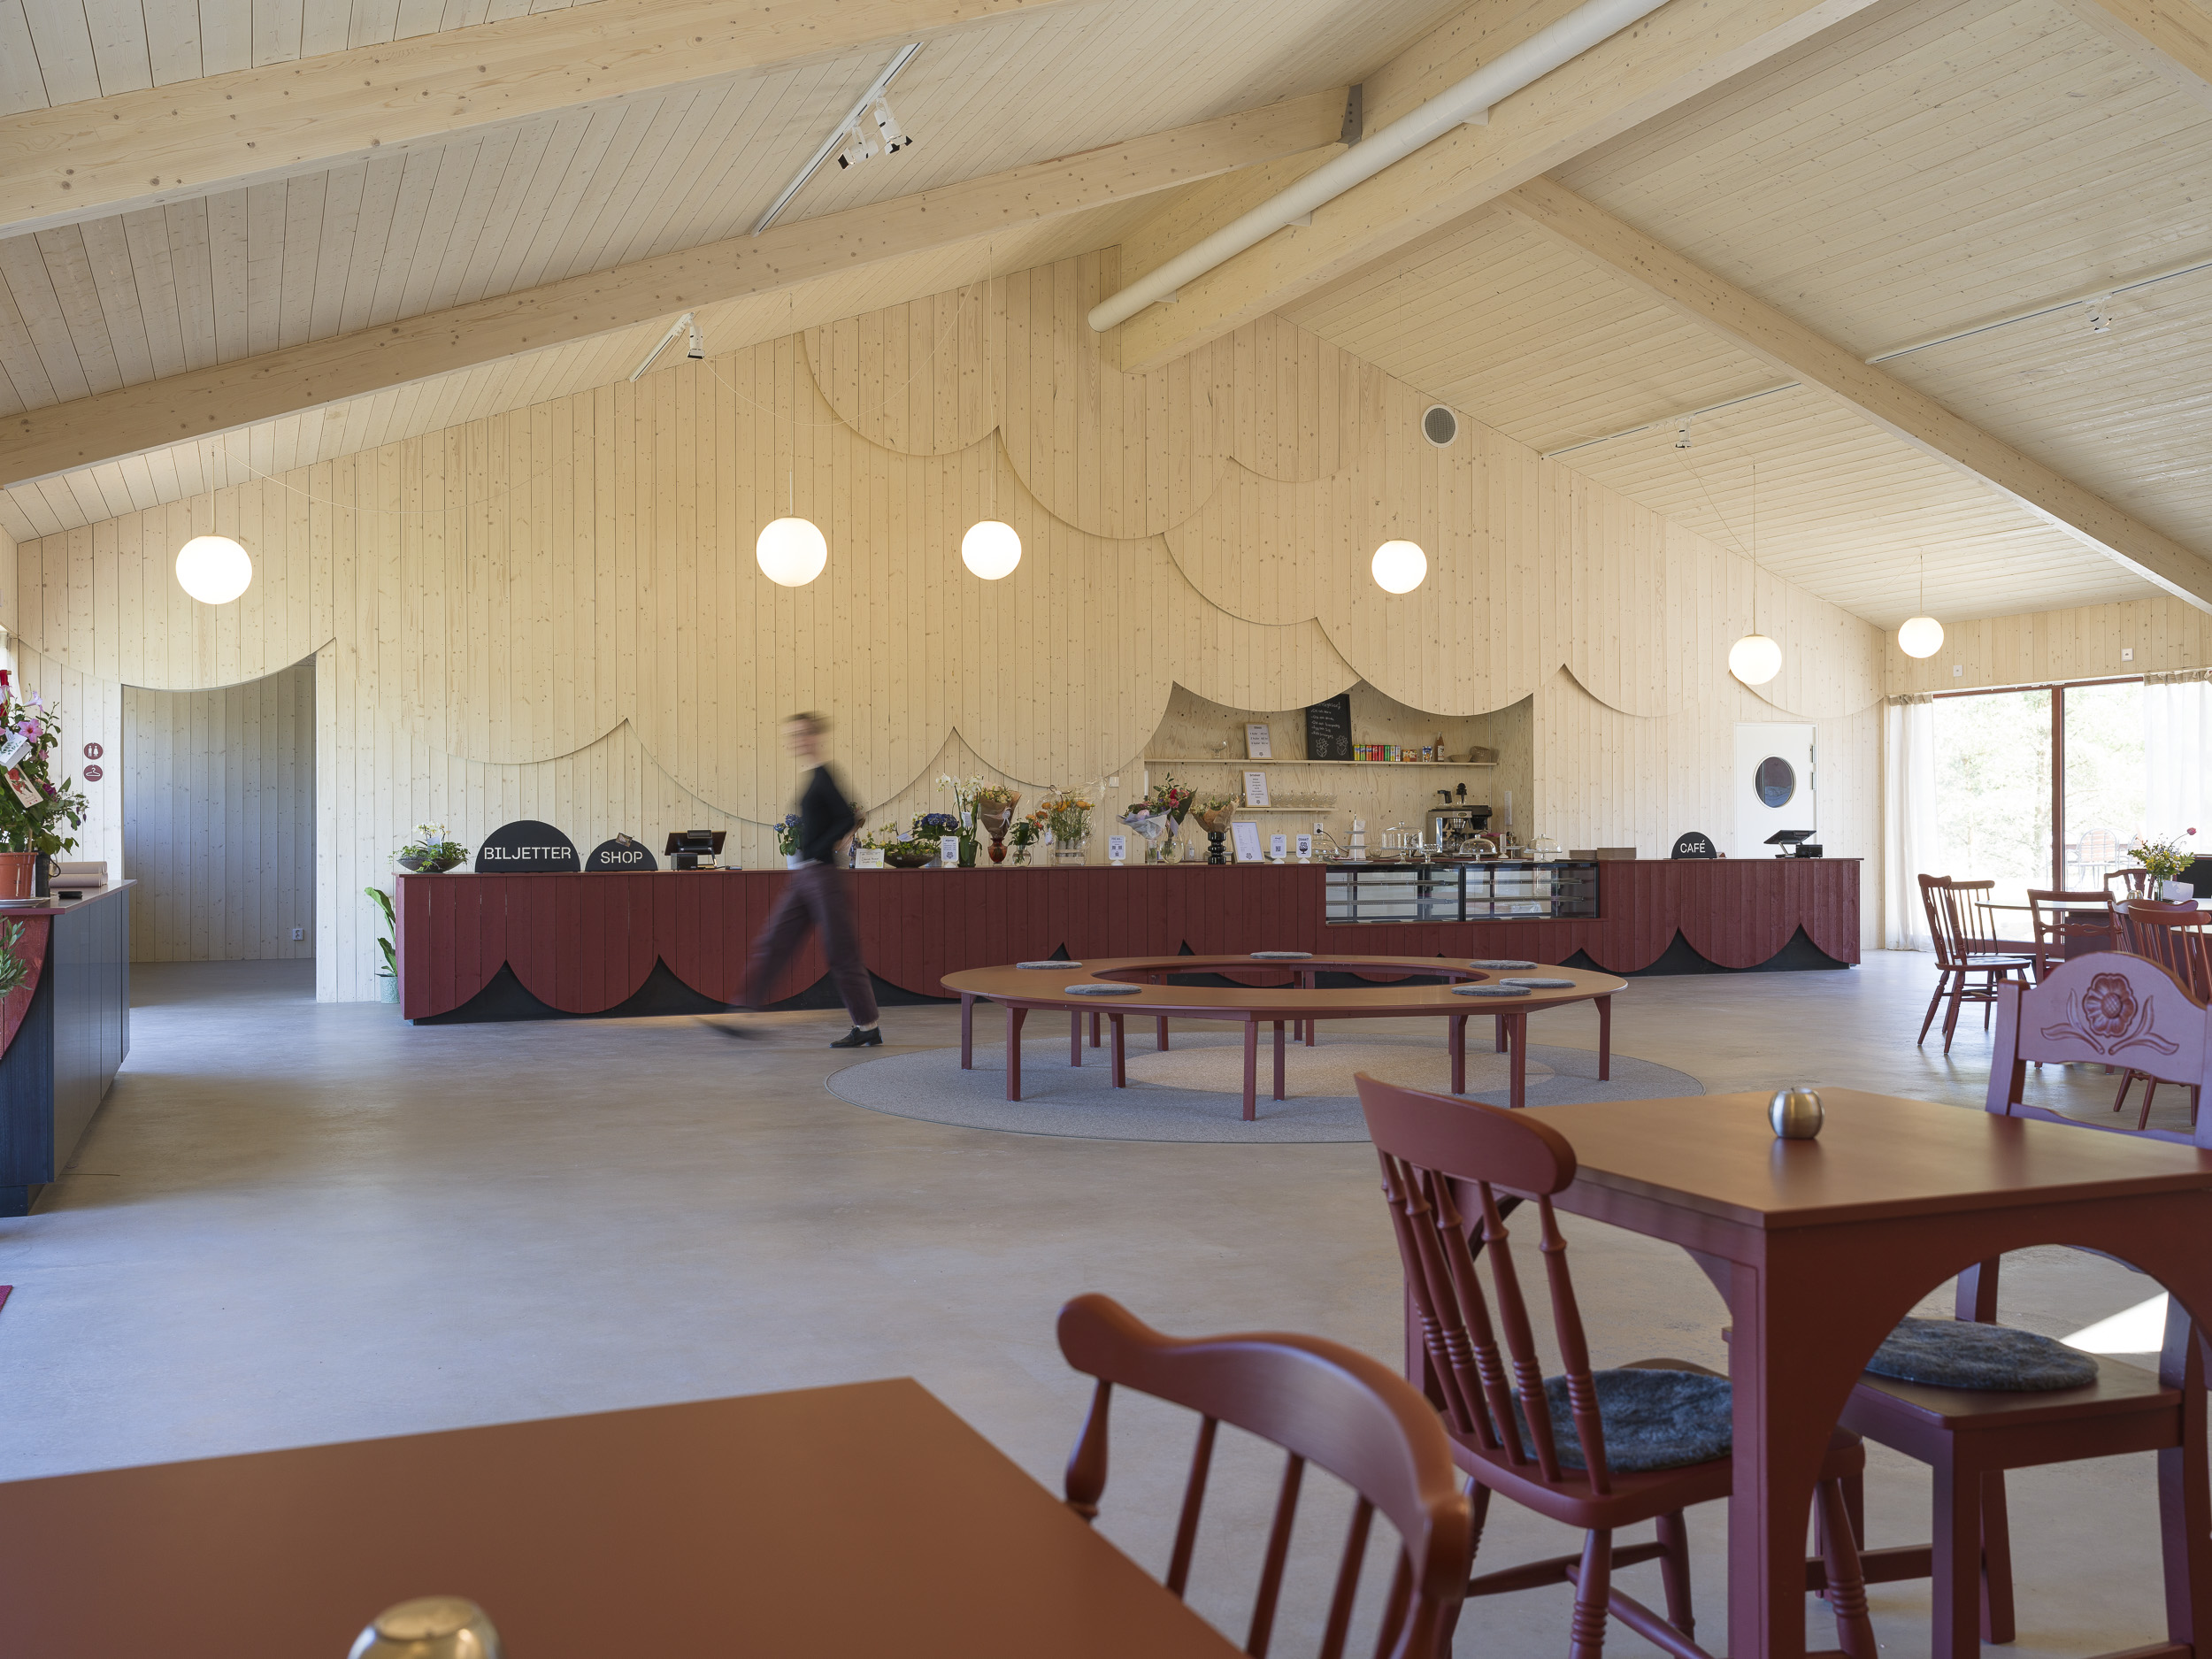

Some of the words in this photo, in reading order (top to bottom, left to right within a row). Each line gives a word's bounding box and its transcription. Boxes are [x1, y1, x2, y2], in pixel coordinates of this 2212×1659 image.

[1679, 839, 1706, 854] CAFÉ
[483, 847, 572, 860] BILJETTER
[600, 851, 643, 864] SHOP
